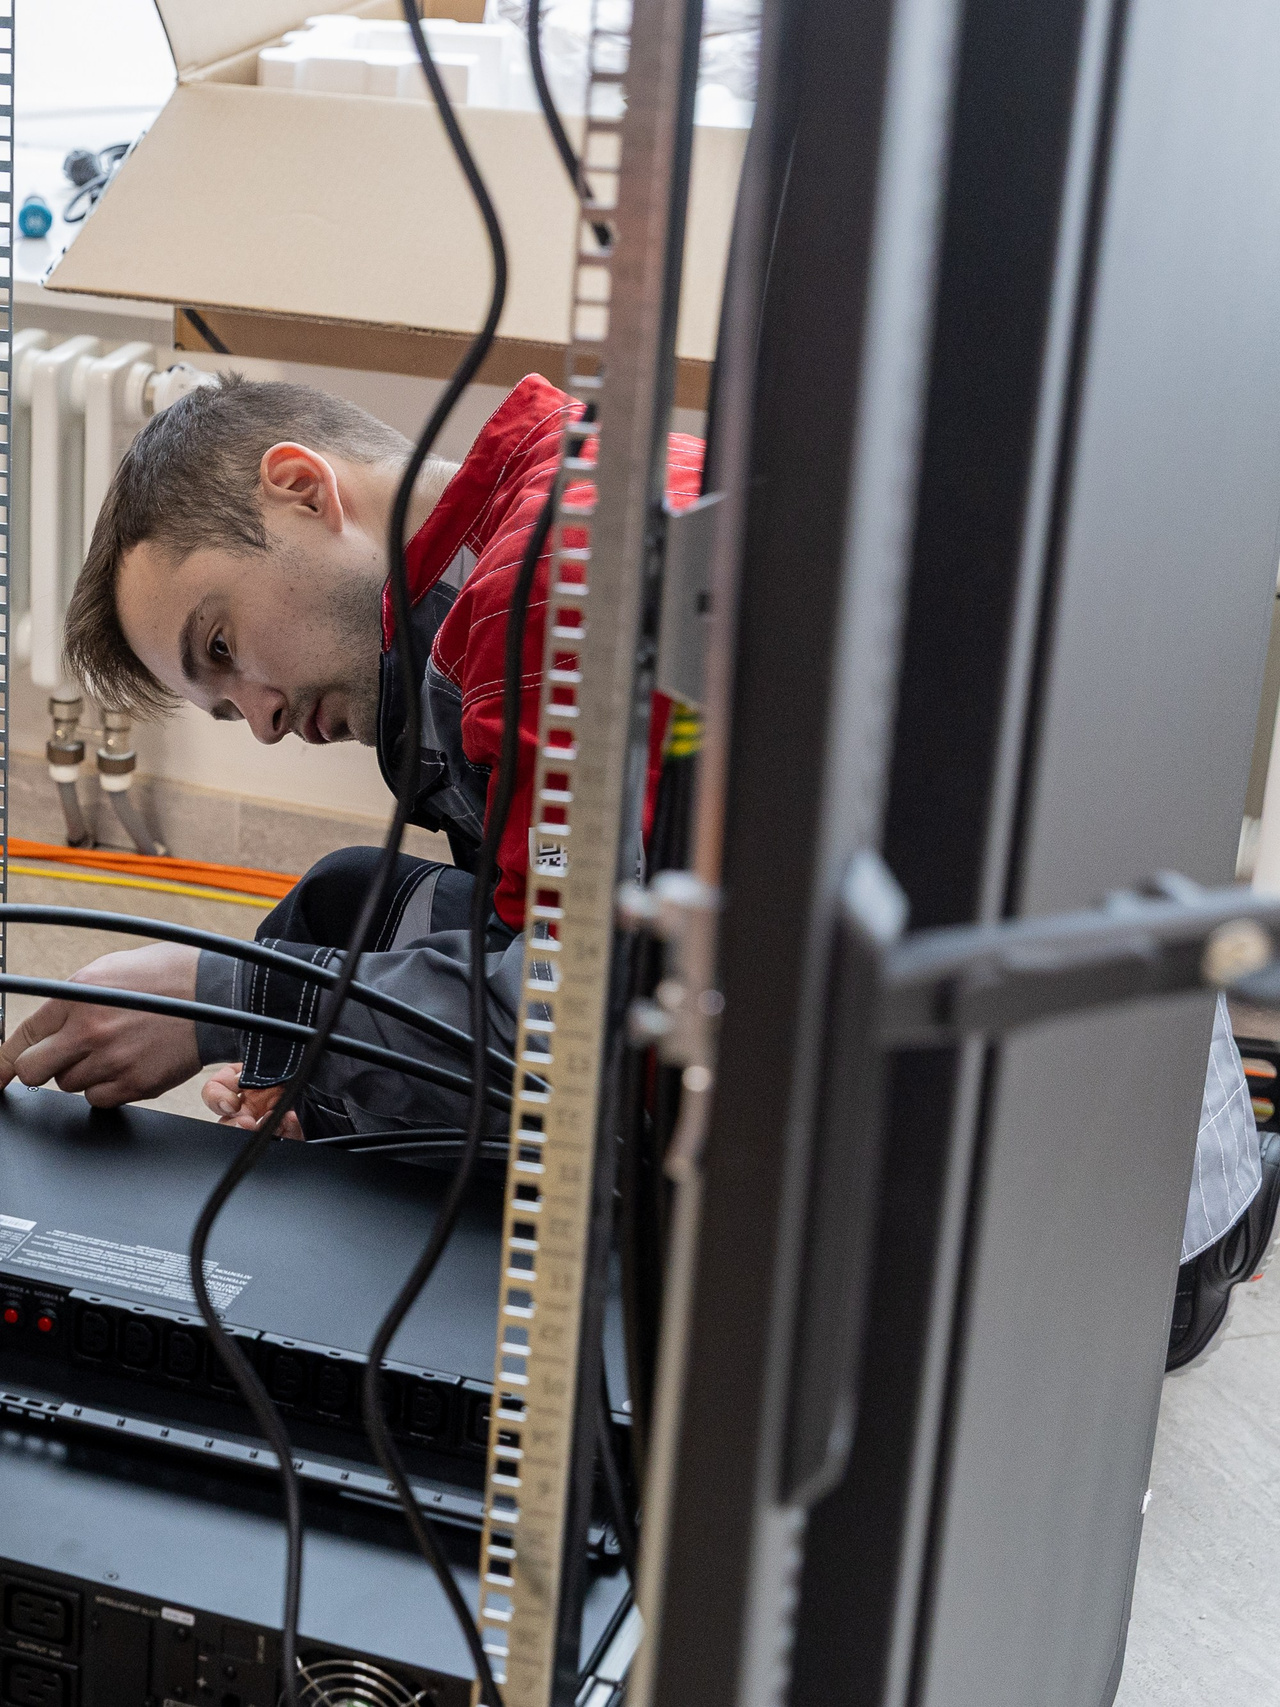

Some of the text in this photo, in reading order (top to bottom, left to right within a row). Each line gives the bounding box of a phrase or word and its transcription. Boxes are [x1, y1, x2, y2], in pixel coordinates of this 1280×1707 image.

[210, 1273, 248, 1286] ATTENTION
[214, 1268, 253, 1280] ATTENTION
[204, 1284, 241, 1296] CAUTION
[206, 1279, 244, 1292] CAUTION
